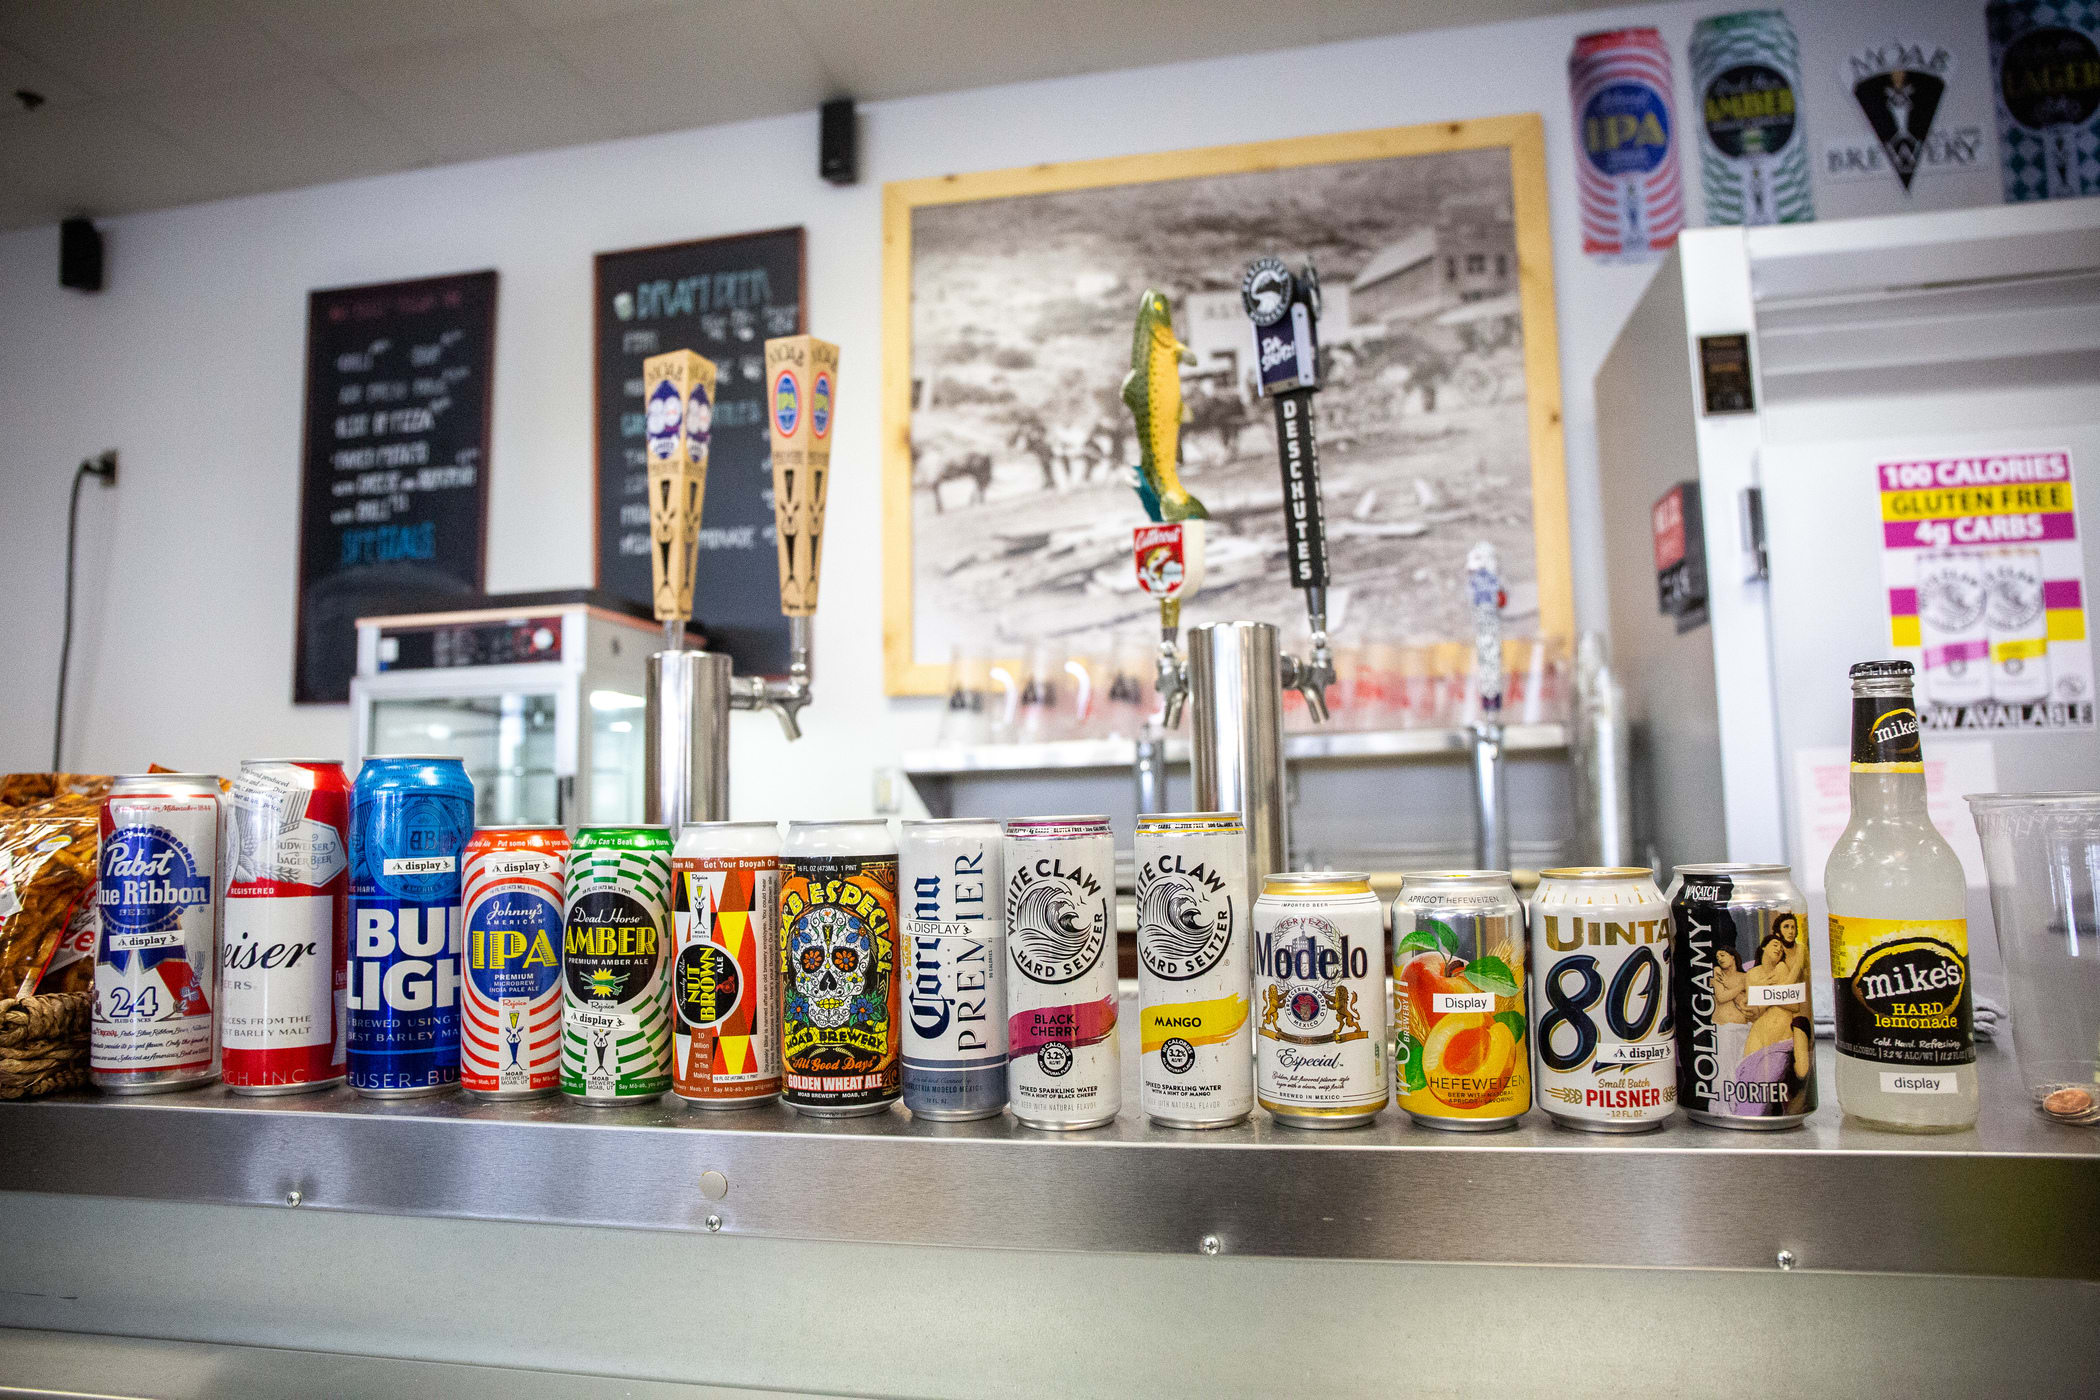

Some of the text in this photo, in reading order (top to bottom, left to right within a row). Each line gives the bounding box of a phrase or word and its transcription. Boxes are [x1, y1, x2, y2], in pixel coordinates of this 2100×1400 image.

[1587, 112, 1667, 152] IPA
[1883, 455, 2067, 488] 100 CALORIES
[1283, 399, 1313, 580] DESCHUTES
[1892, 485, 2063, 515] GLUTEN FREE
[1953, 514, 2044, 541] CARBS
[106, 842, 175, 877] Pabst
[405, 860, 441, 872] display
[504, 862, 540, 874] display
[703, 859, 765, 870] Get Your Booyah
[1158, 855, 1226, 893] CLAW
[98, 879, 207, 906] lue Ribbon
[231, 887, 274, 895] REGISTERED
[1007, 859, 1101, 937] WHITE CLAW
[1408, 895, 1500, 904] APRICOT HEFEWEIZEN
[487, 900, 543, 920] Johnny's
[573, 906, 640, 923] Dead Horse
[809, 880, 893, 973] ESPECIAL
[914, 922, 960, 935] DISPLAY
[1543, 914, 1670, 952] UINTA
[130, 935, 168, 948] display
[472, 929, 559, 969] IPA
[565, 925, 657, 956] AMBER
[1063, 913, 1103, 975] SELTZER
[1185, 910, 1228, 971] SELTZER
[223, 932, 317, 969] eiser
[955, 851, 985, 1052] PREMIER
[1255, 931, 1368, 980] Modelo
[568, 957, 598, 965] PREMIUM
[716, 956, 724, 974] ALE
[1018, 951, 1055, 977] HARD
[1143, 946, 1177, 974] HARD
[347, 958, 461, 1012] LIGH
[494, 973, 534, 981] PREMIUM
[687, 963, 700, 1003] NUT
[700, 947, 716, 1021] BROWN
[1863, 960, 1962, 1000] mike's
[109, 986, 158, 1018] 24
[1763, 988, 1801, 1001] Display
[590, 1001, 615, 1012] Rejoice
[1445, 997, 1487, 1010] Display
[1689, 922, 1719, 1101] POLYGAMY
[1892, 1002, 1944, 1016] HARD
[251, 1015, 312, 1025] FROM THE
[351, 1015, 450, 1028] BREWED USING
[579, 1012, 614, 1028] display
[1034, 1014, 1074, 1025] BLACK
[1154, 1016, 1202, 1028] MANGO
[1293, 1019, 1319, 1028] MEXICO
[1402, 999, 1411, 1043] BREWERY
[1874, 1015, 1958, 1029] lemonade
[234, 1027, 312, 1037] BARLEY MALT
[376, 1031, 436, 1041] BARLEY
[820, 1031, 884, 1049] BREWERY
[1030, 1026, 1079, 1037] CHERRY
[1919, 1038, 1961, 1050] Refreshing
[1046, 1051, 1064, 1060] 3.2%
[1276, 1048, 1341, 1072] Especial
[1629, 1046, 1664, 1060] display
[811, 1058, 839, 1071] Good
[788, 1074, 821, 1090] GOLDEN
[823, 1076, 863, 1091] WHEAT
[864, 1074, 883, 1088] ALE
[1162, 1084, 1198, 1092] SPARKLING
[1430, 1075, 1525, 1090] HEFEWEIZEN
[1598, 1077, 1651, 1089] Small Batch
[1893, 1075, 1941, 1091] display
[1585, 1088, 1660, 1109] PILSNER
[1724, 1081, 1789, 1103] PORTER
[1611, 1109, 1643, 1118] 12 FL. OZ
